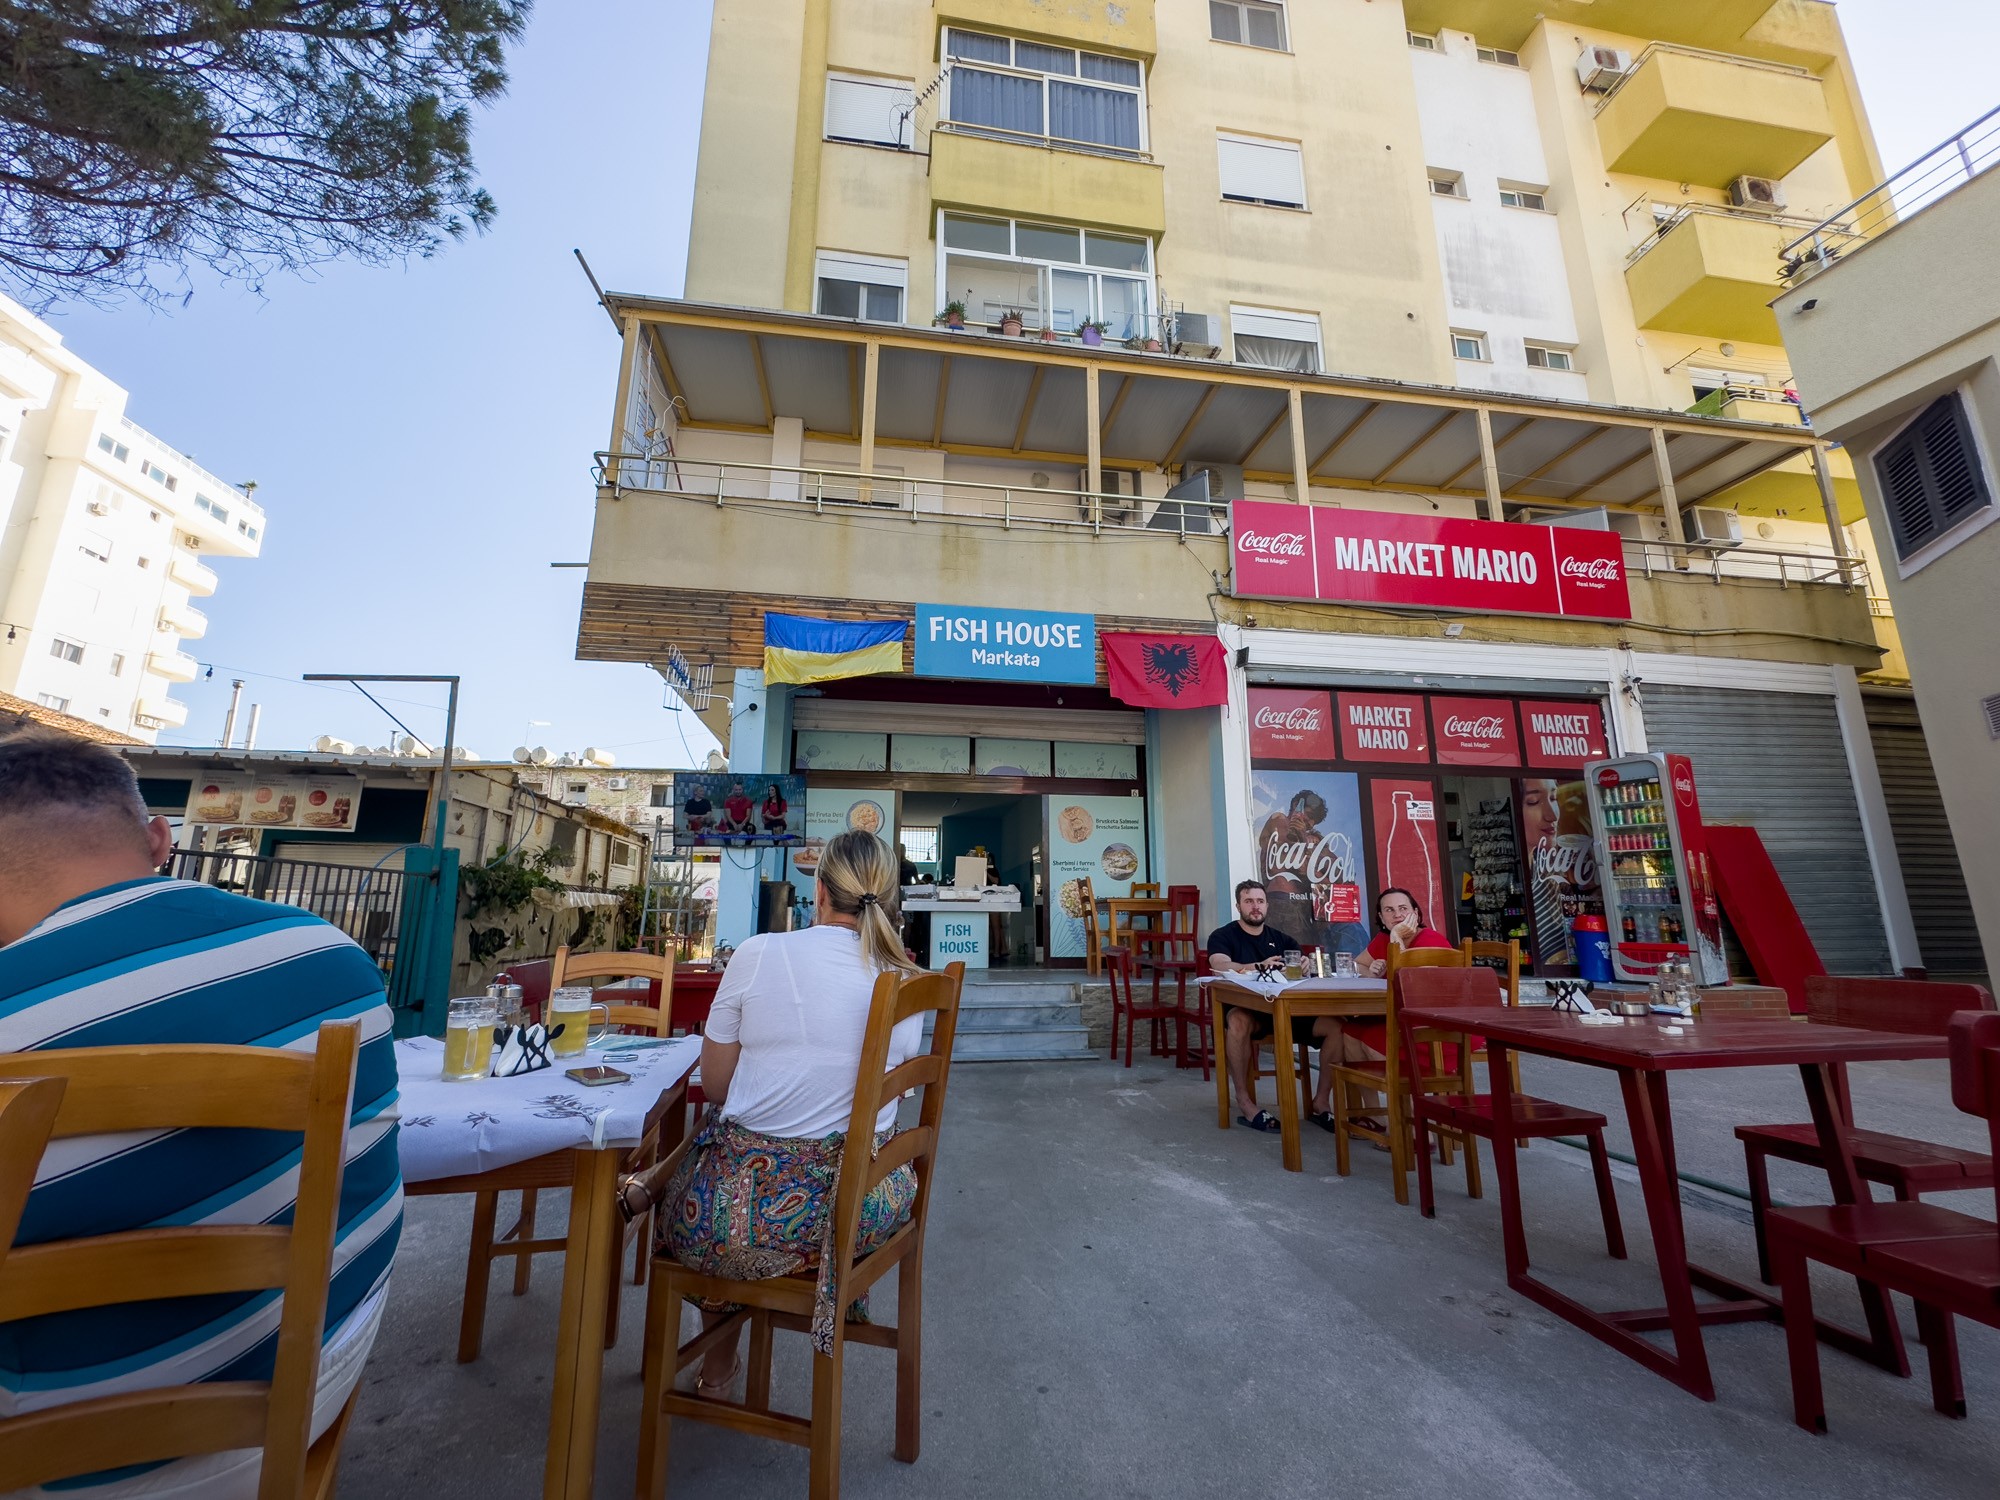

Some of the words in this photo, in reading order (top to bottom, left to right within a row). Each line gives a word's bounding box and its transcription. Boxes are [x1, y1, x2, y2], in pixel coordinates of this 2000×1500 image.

[1238, 530, 1306, 556] Coca-Cola
[1270, 557, 1288, 565] Magic
[1334, 536, 1445, 578] MARKET
[1451, 545, 1538, 585] MARIO
[1560, 556, 1619, 580] Coca-Cola
[929, 616, 988, 644] FISH
[995, 621, 1082, 648] HOUSE
[971, 648, 1041, 667] Markata
[1254, 706, 1321, 731] Coca-Cola
[1349, 705, 1412, 728] MARKET
[1444, 715, 1505, 739] Coca-Cola
[1531, 713, 1589, 735] MARKET
[1357, 728, 1409, 750] MARIO
[1540, 735, 1588, 757] MARIO
[1289, 892, 1308, 901] Real
[1560, 894, 1577, 902] Real
[944, 924, 971, 937] FISH
[939, 941, 979, 954] HOUSE
